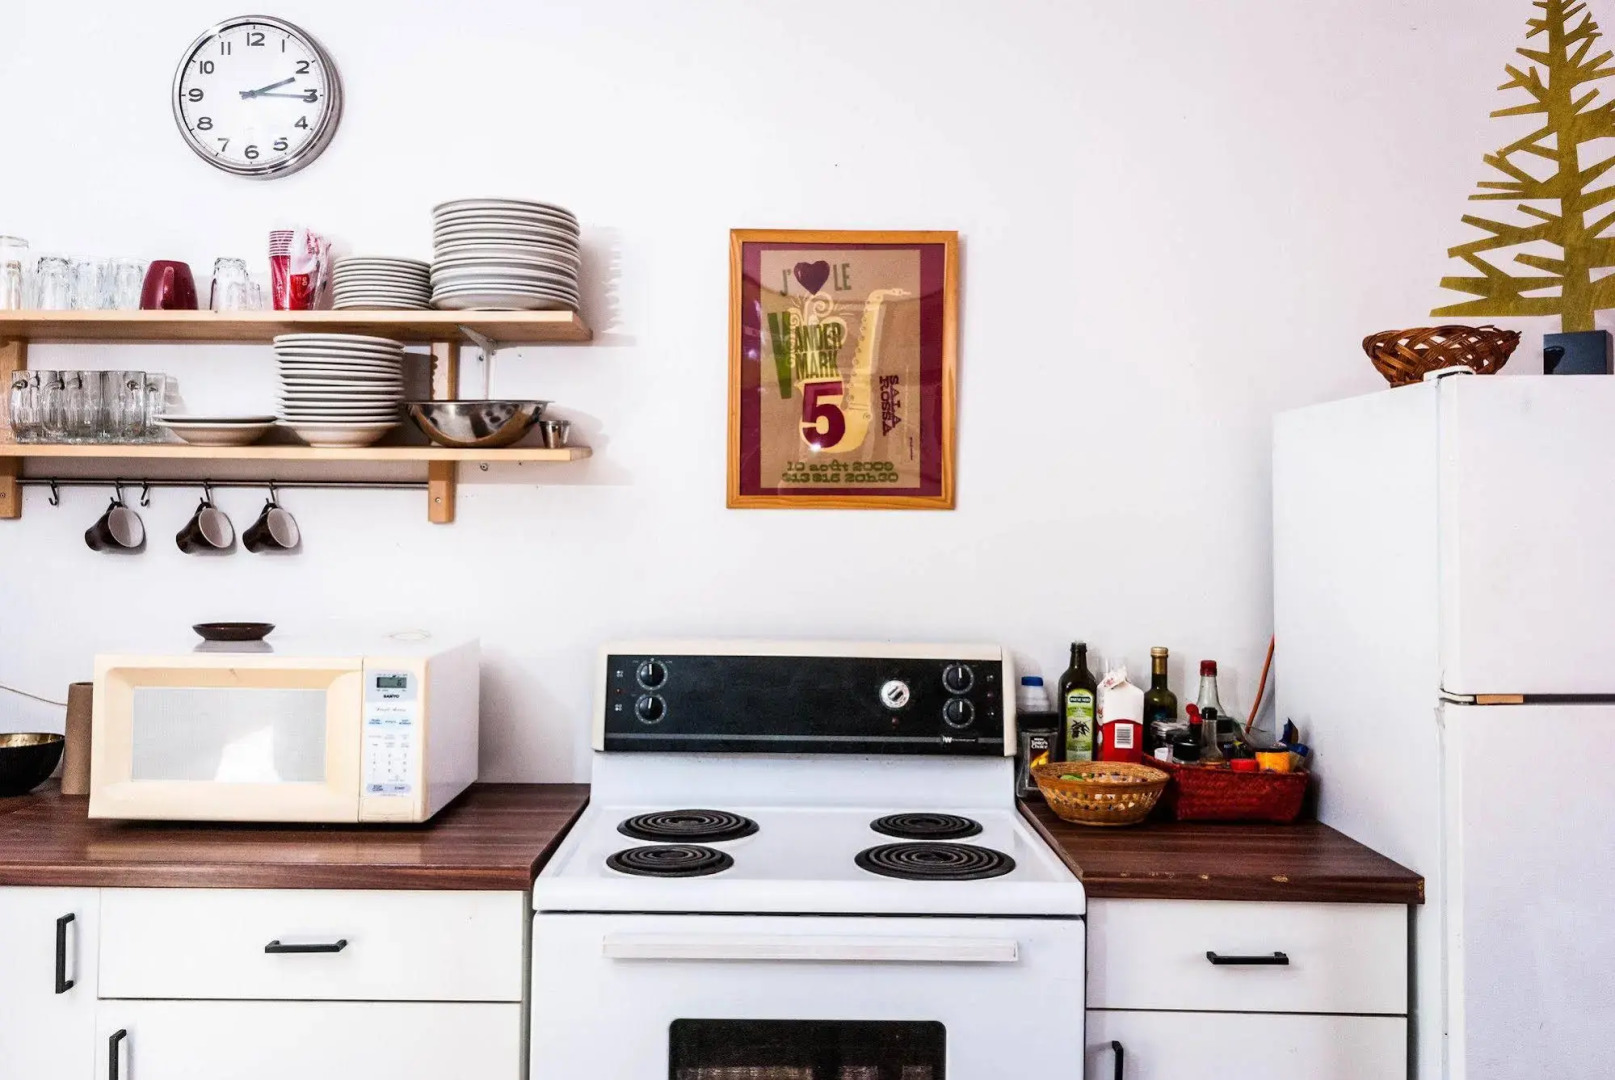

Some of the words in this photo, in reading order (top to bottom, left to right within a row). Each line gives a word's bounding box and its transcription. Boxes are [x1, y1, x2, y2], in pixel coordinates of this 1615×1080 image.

[247, 32, 265, 47] 12
[281, 39, 285, 53] 1
[221, 41, 231, 55] 11
[199, 60, 215, 75] 10
[295, 60, 310, 75] 2
[188, 88, 204, 102] 9
[302, 88, 318, 103] 3
[196, 116, 213, 131] 8
[294, 115, 309, 130] 4
[217, 137, 231, 152] 7
[272, 136, 289, 151] 5
[244, 145, 260, 160] 6
[832, 262, 852, 291] LE
[879, 375, 893, 437] ROSSA
[889, 374, 902, 429] SALA
[801, 380, 846, 449] 5
[786, 460, 806, 472] 10
[844, 471, 900, 484] 20h30
